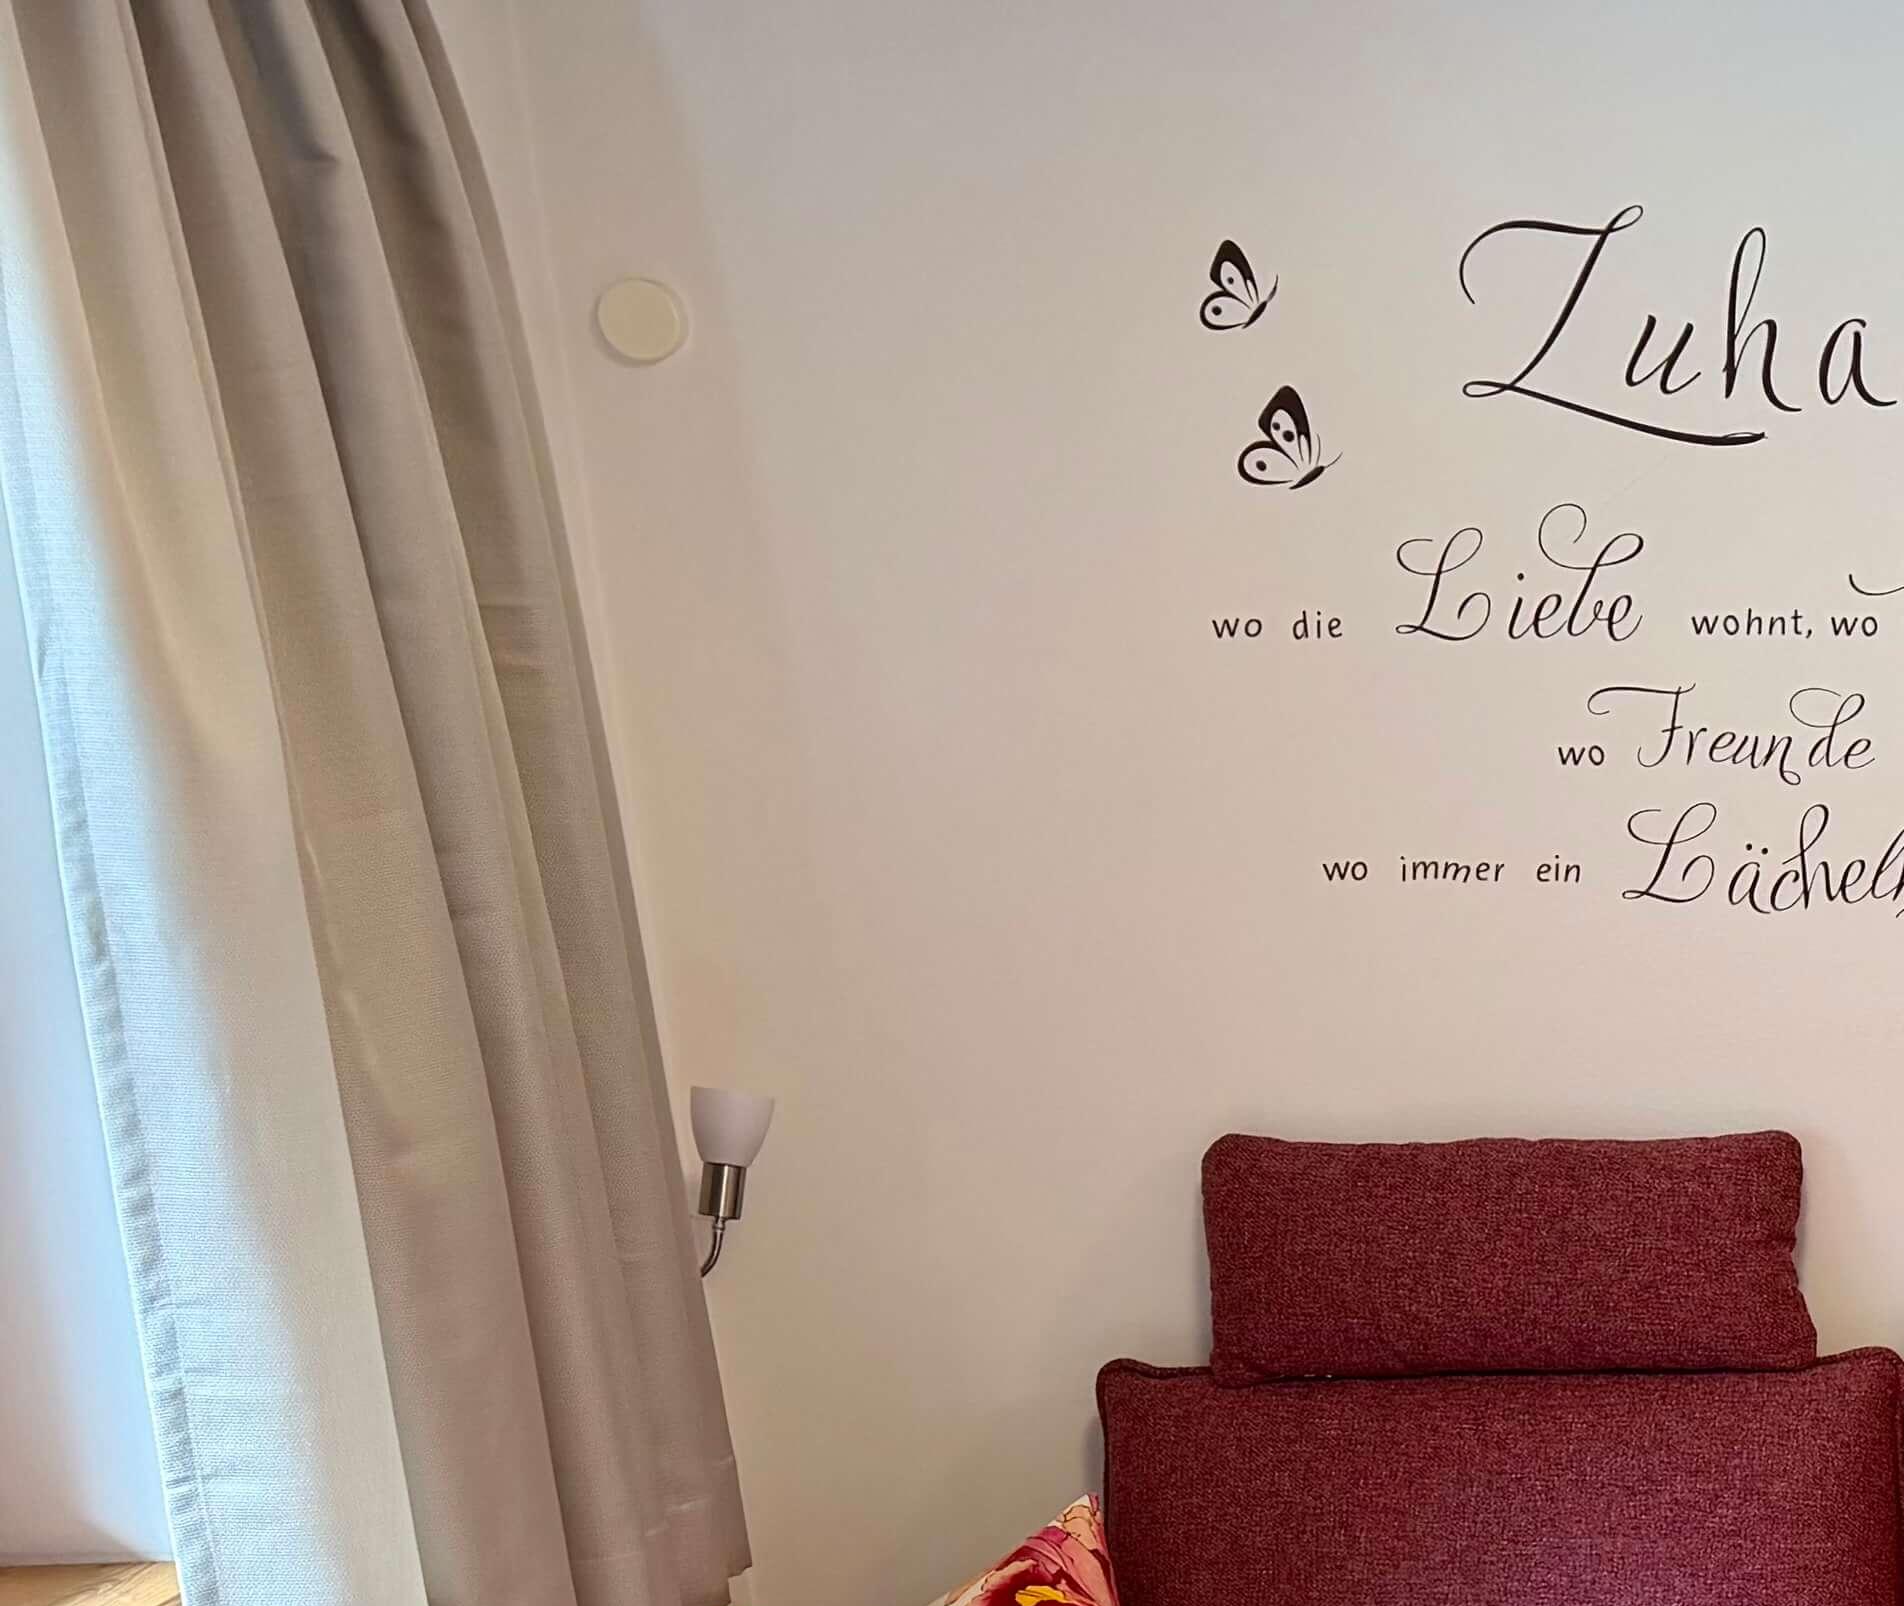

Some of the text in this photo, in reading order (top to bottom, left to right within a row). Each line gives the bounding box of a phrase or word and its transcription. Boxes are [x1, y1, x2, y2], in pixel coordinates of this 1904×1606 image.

[1210, 616, 1264, 642] wo
[1291, 608, 1344, 642] die
[1393, 501, 1646, 643] Liebe
[1689, 606, 1814, 641] wohnt,
[1829, 614, 1880, 639] wo
[1556, 743, 1607, 768] wo
[1585, 681, 1877, 787] Freunde
[1320, 859, 1370, 883] wo
[1398, 854, 1506, 886] immer
[1535, 853, 1582, 885] ein
